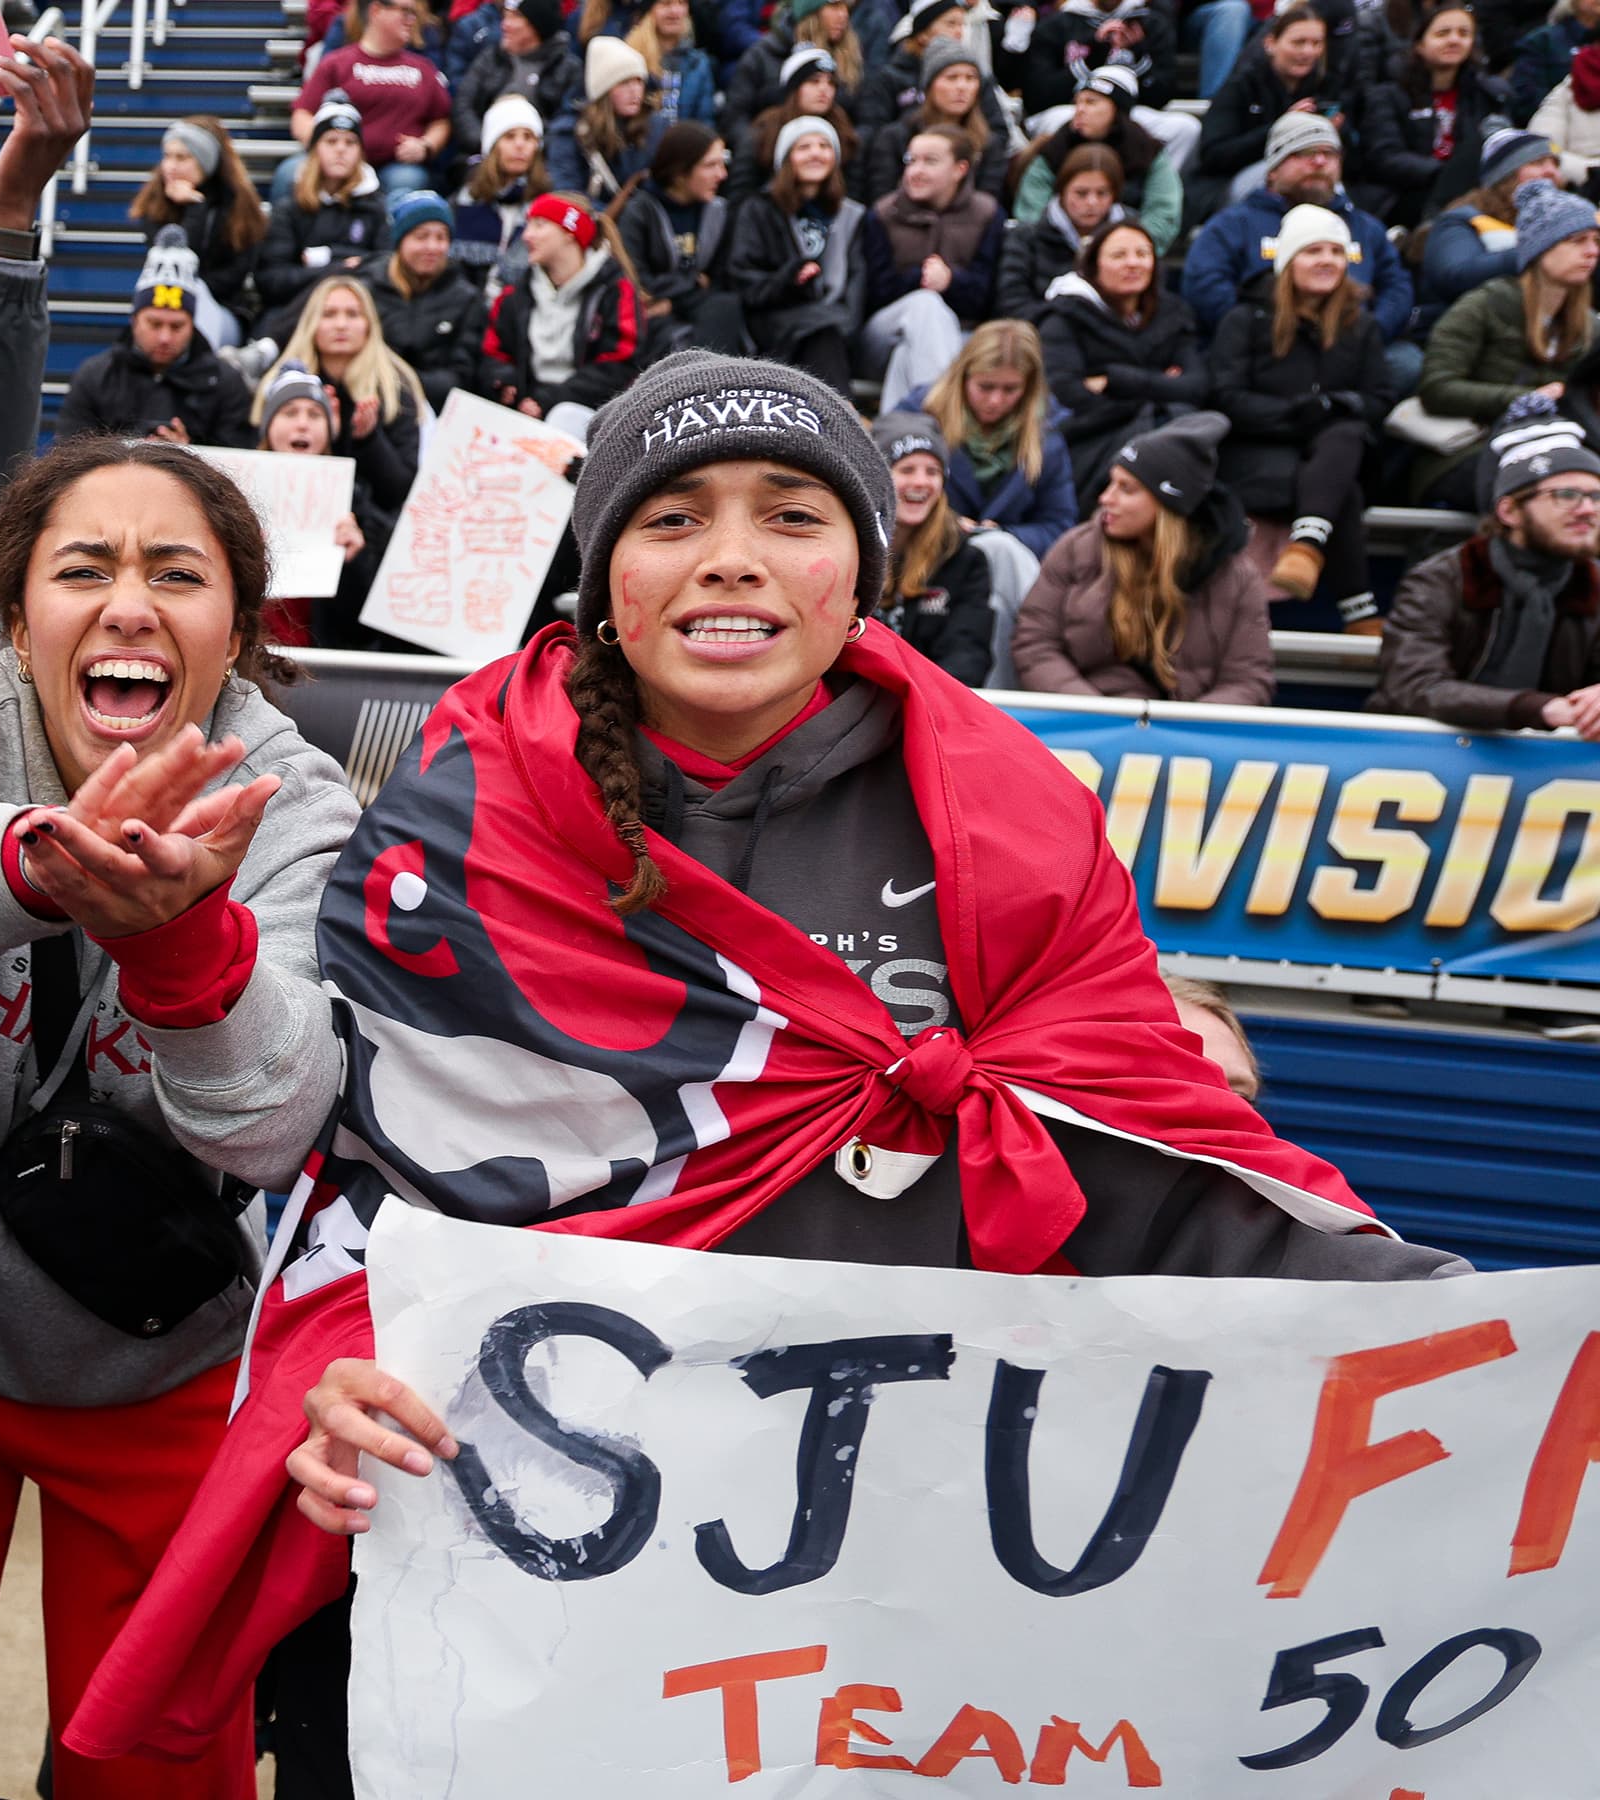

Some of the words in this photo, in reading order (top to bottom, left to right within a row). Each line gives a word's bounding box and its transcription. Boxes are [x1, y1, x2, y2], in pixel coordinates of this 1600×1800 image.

[643, 398, 821, 453] HAWKS
[654, 394, 708, 421] SAINT
[716, 389, 807, 407] JOSEPH'S
[1048, 748, 1600, 932] IVISIO
[449, 1300, 1214, 1599] SJU
[662, 1645, 1163, 1787] TEAM
[1238, 1626, 1543, 1771] 50
